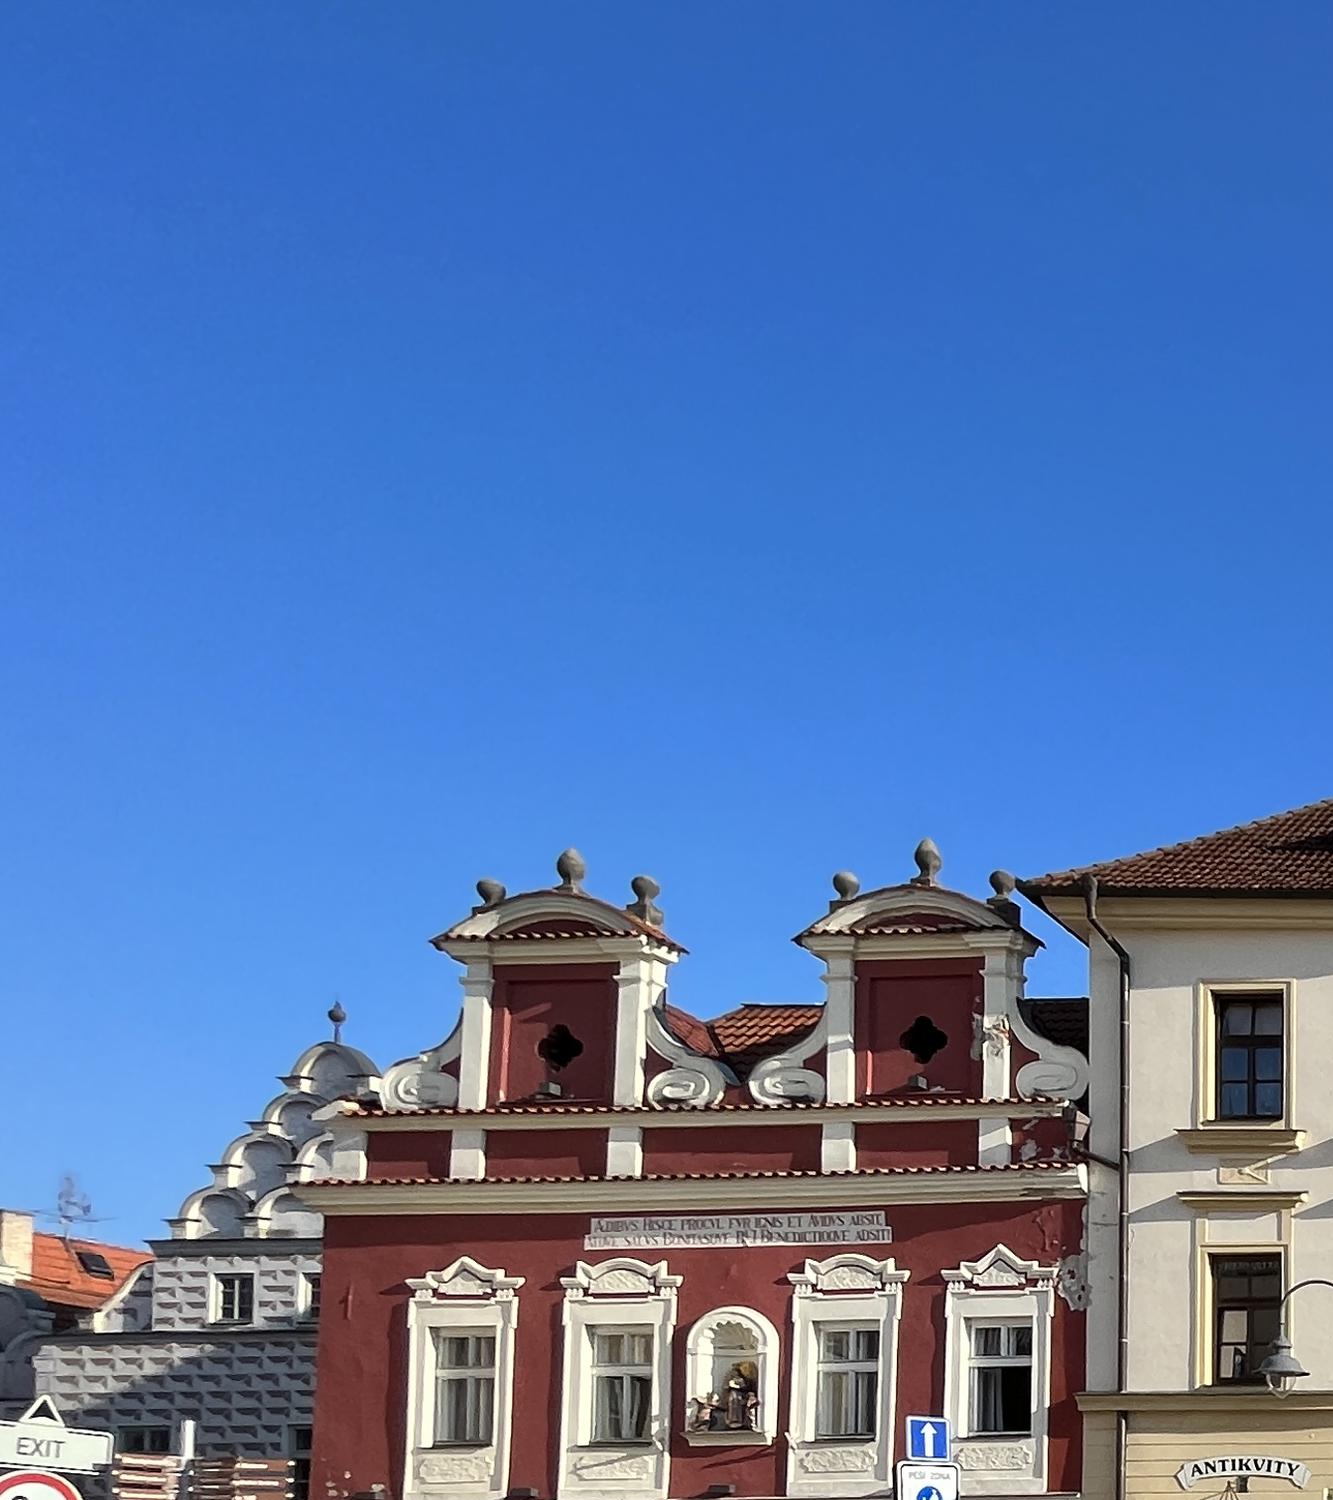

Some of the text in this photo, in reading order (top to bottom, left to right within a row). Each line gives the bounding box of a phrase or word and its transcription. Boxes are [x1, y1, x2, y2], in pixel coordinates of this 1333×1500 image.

[787, 1215, 803, 1228] ET
[16, 1437, 67, 1459] EXIT
[1191, 1458, 1300, 1477] ANTIKVITY
